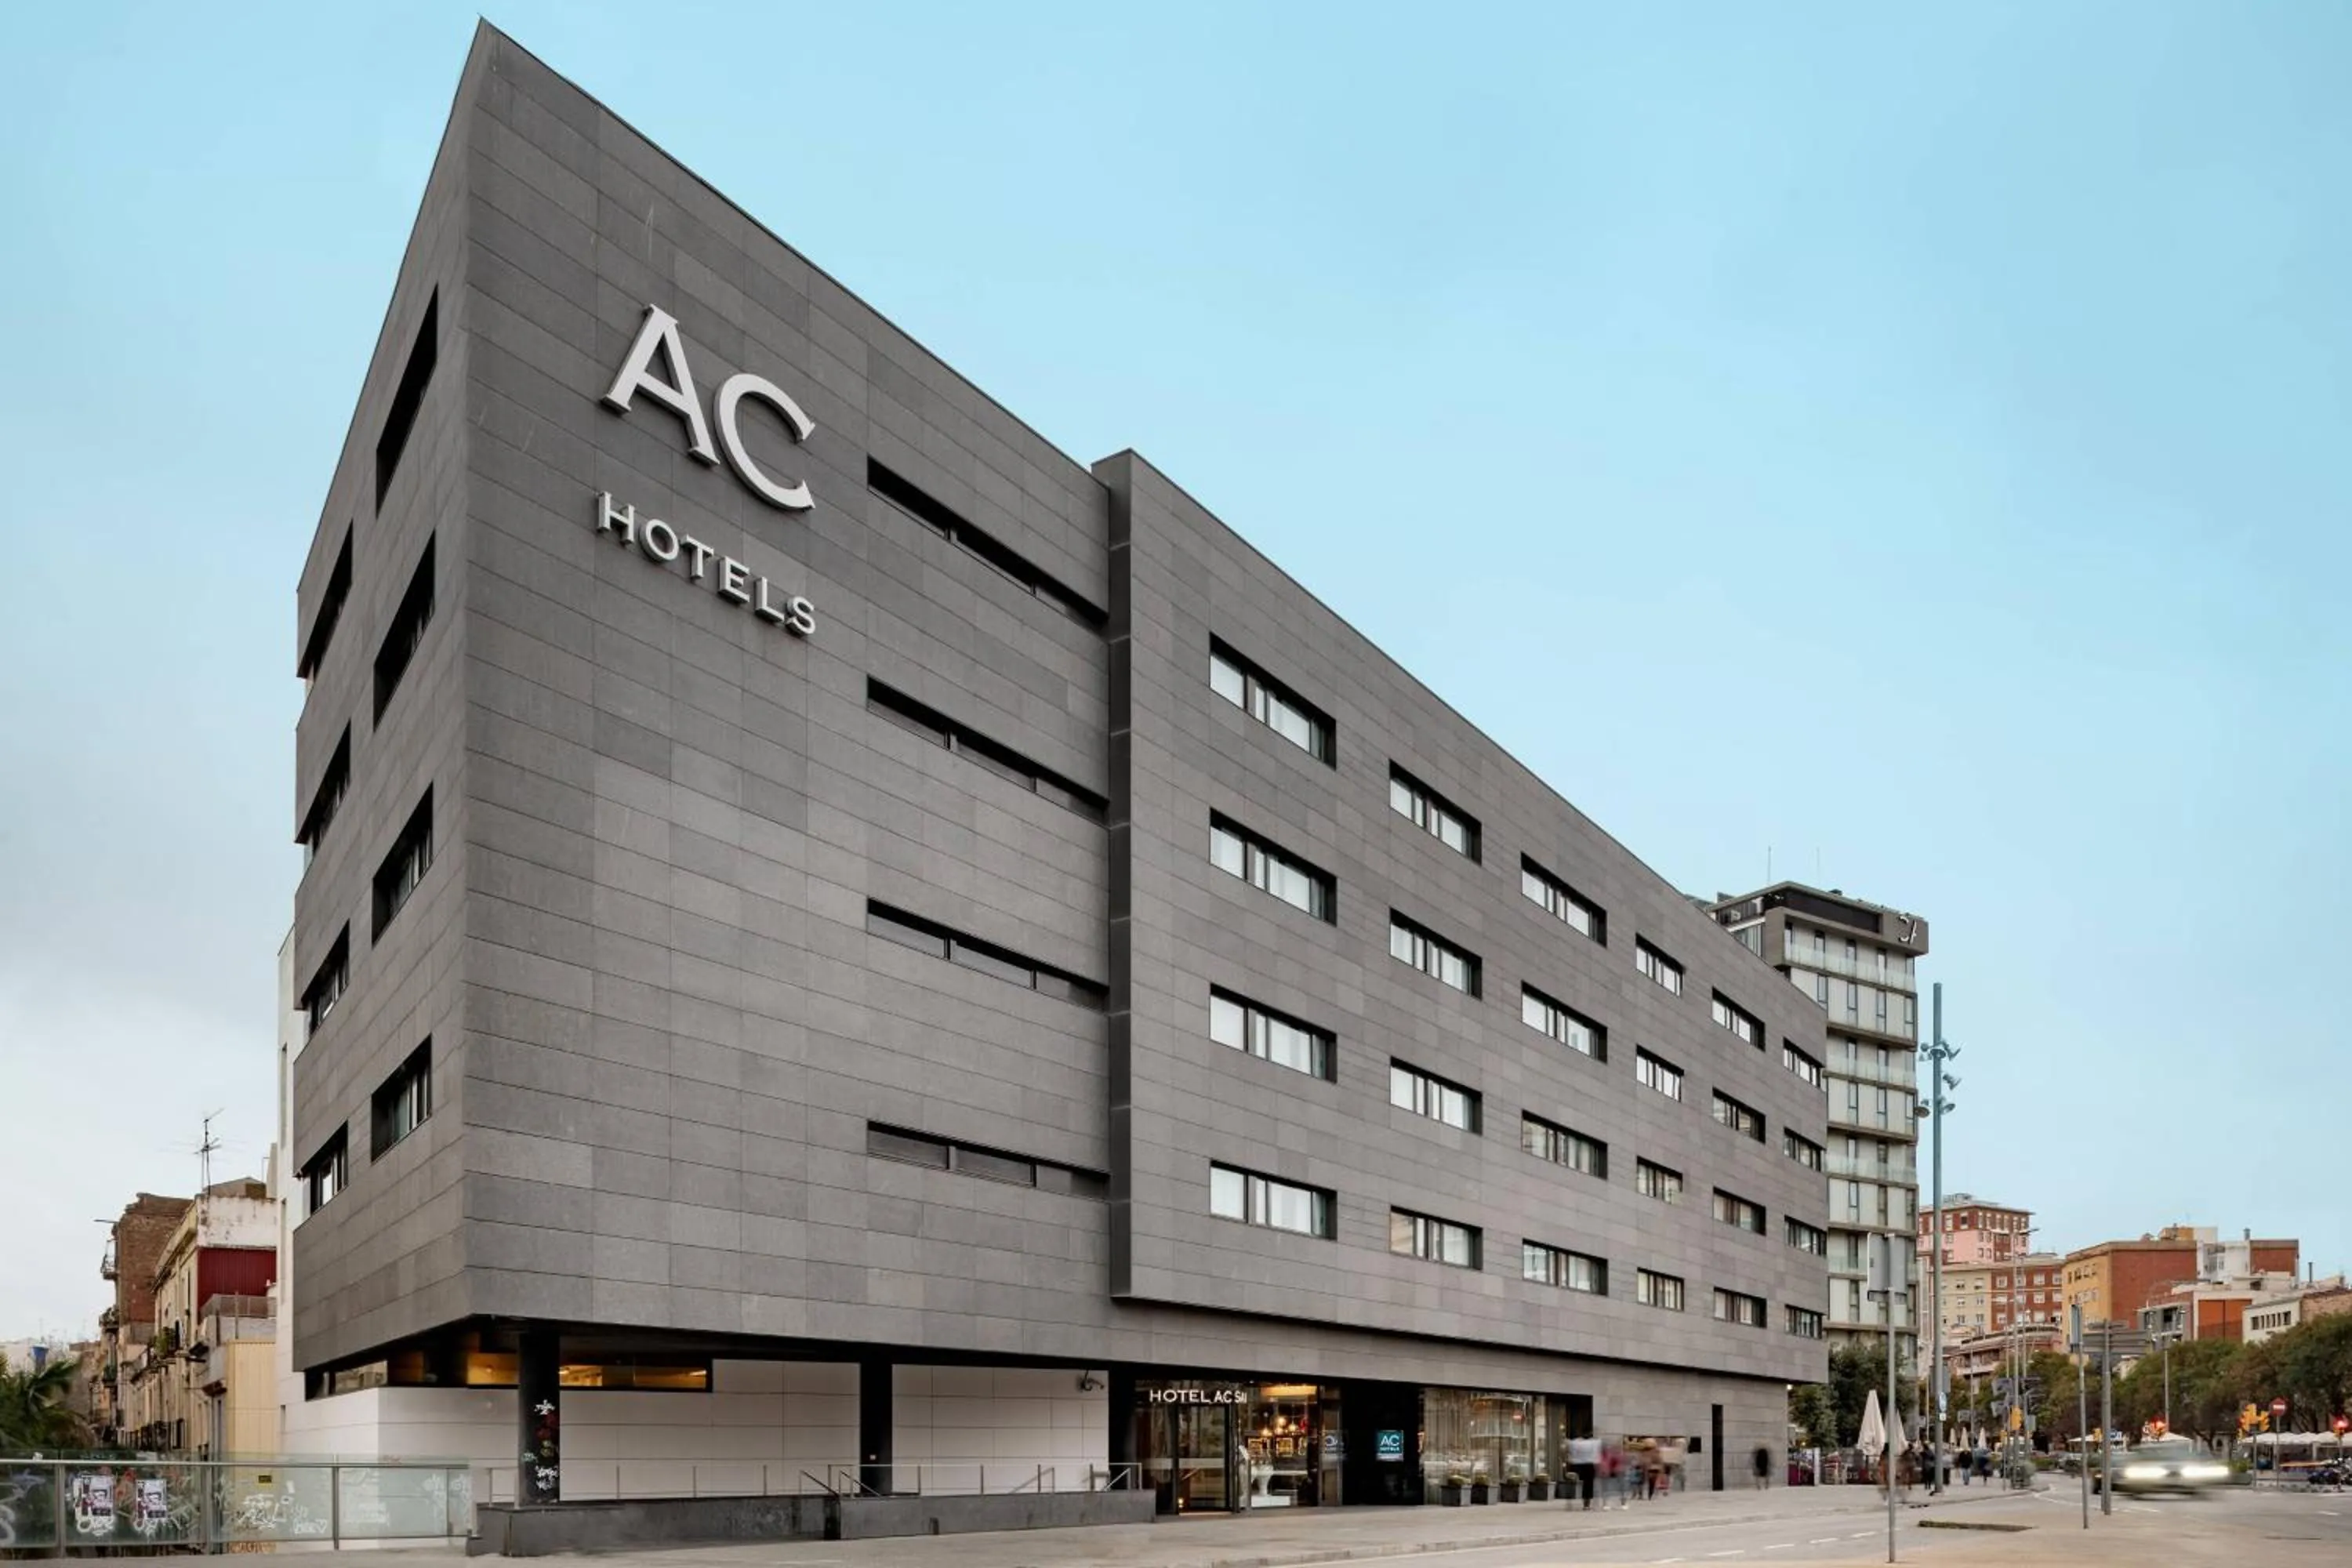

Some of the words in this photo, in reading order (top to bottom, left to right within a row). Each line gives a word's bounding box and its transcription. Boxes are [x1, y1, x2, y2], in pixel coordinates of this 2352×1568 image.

[599, 303, 816, 514] AC
[597, 491, 817, 636] HOTELS
[1149, 1388, 1212, 1404] HOTEL
[1380, 1435, 1399, 1446] AC
